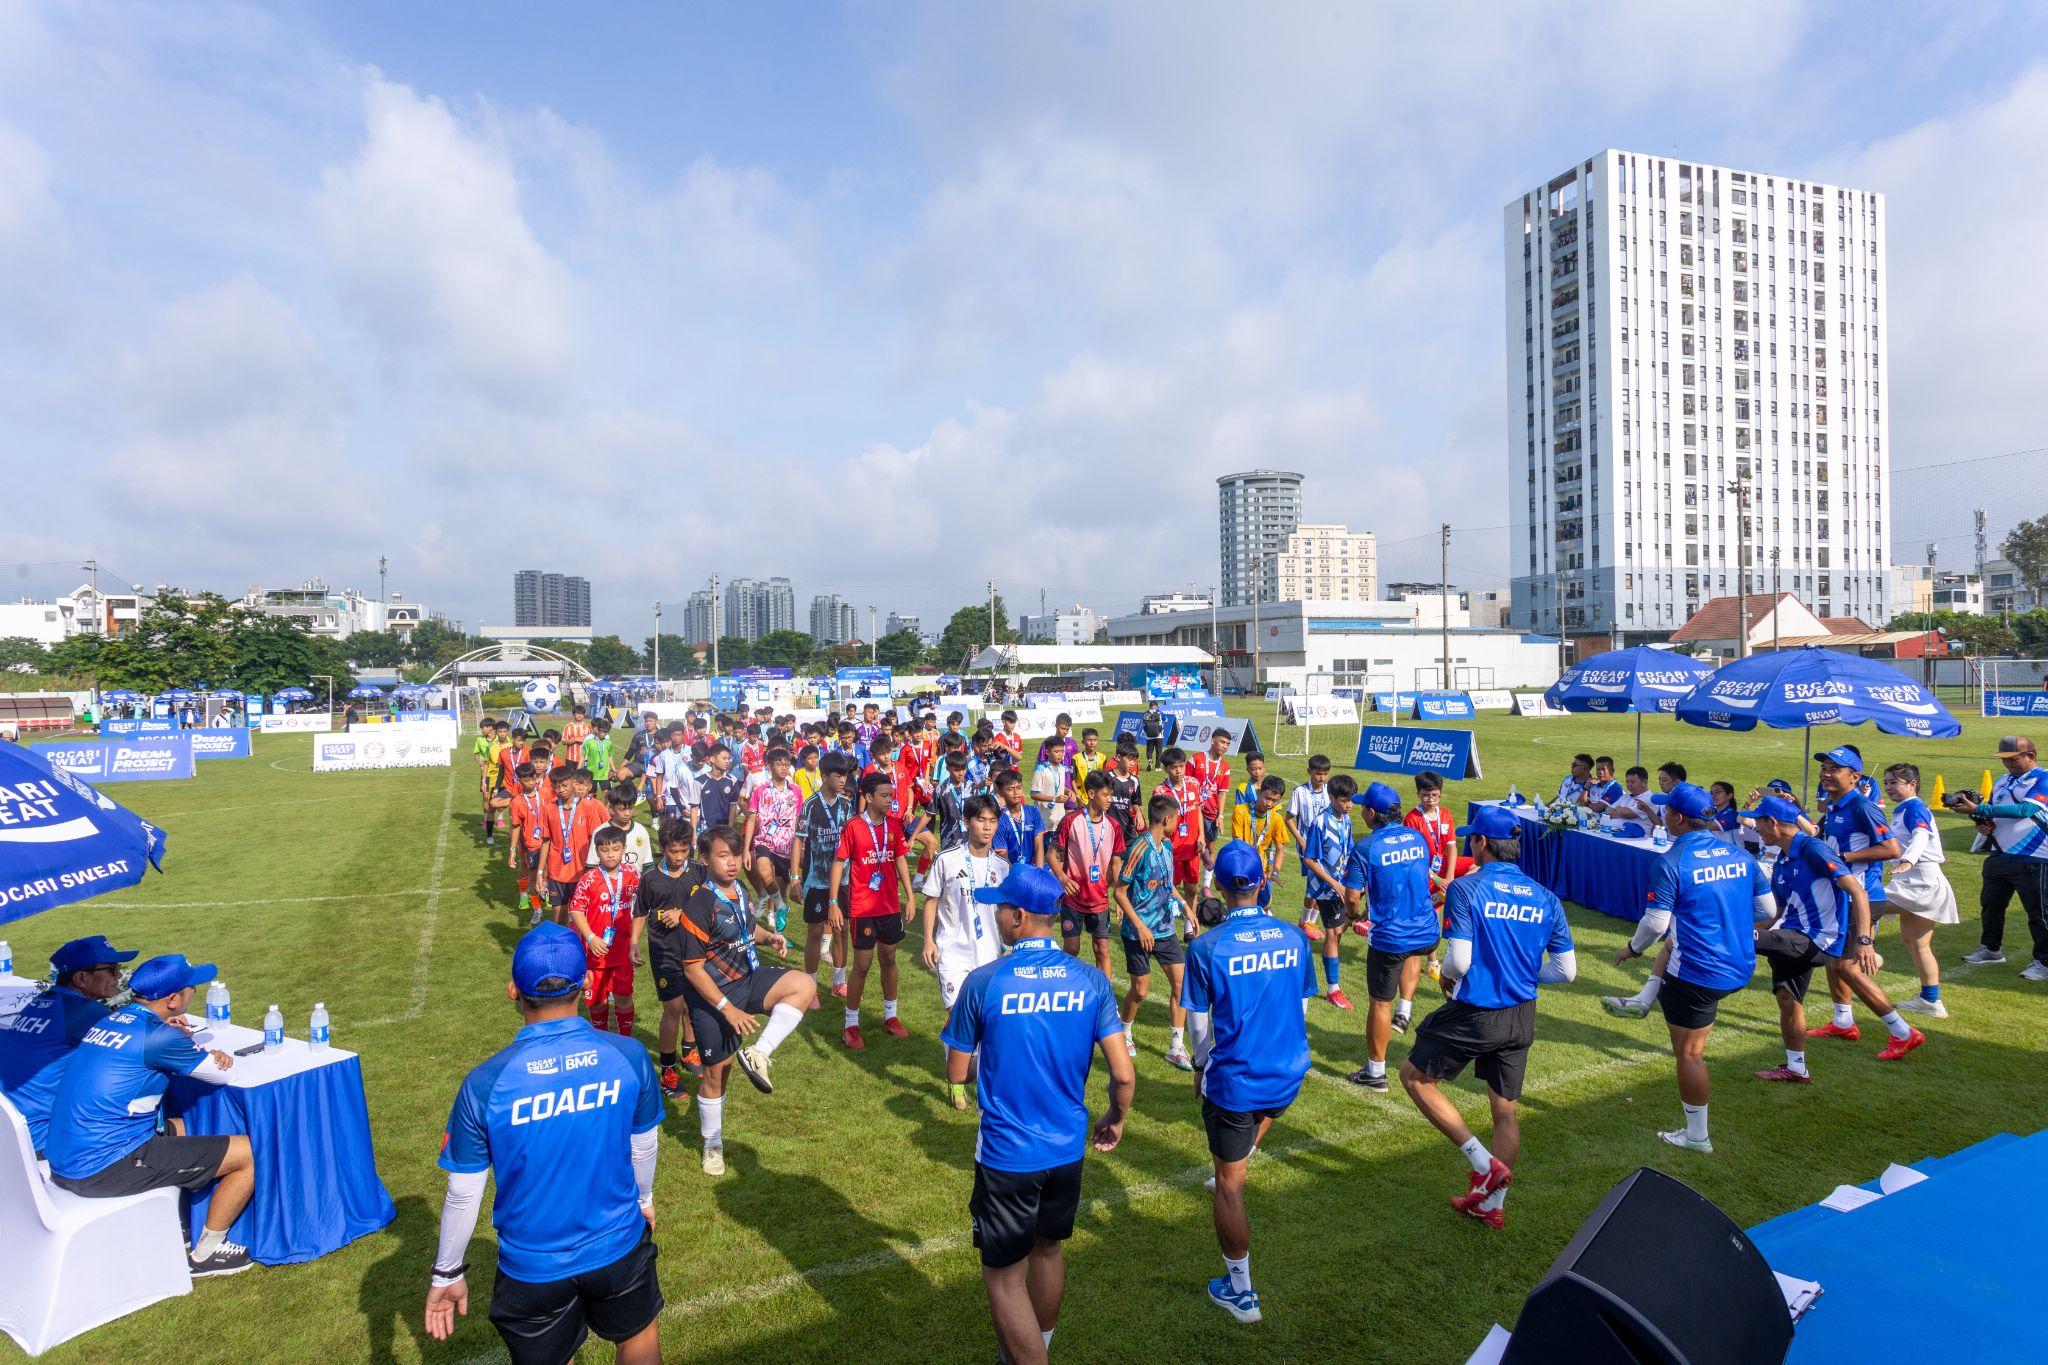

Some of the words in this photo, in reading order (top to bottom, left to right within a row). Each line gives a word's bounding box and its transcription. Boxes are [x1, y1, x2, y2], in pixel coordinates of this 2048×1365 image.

[1583, 670, 1630, 678] POCARI
[1636, 671, 1689, 679] POCARI
[1717, 680, 1771, 691] POCARI
[1784, 681, 1853, 692] POCARI
[1864, 685, 1920, 695] POCARI
[1711, 687, 1759, 697] SWEAT
[1785, 688, 1847, 698] SWEAT
[1870, 692, 1922, 702] SWEAT
[1805, 709, 1838, 718] POCARI
[191, 734, 233, 743] DREAM
[1370, 735, 1403, 745] POCARI
[1368, 743, 1399, 753] SWEAT
[1411, 737, 1453, 752] DREAM
[46, 749, 100, 760] POCARI
[115, 747, 172, 760] DREAM
[421, 746, 443, 754] BMG
[1408, 750, 1455, 768] PROJECT
[112, 757, 176, 773] PROJECT
[1381, 846, 1425, 867] COACH
[60, 860, 129, 888] SWEAT
[1692, 862, 1747, 885] COACH
[1513, 887, 1533, 896] BMG
[1484, 901, 1544, 924] COACH
[1261, 930, 1283, 941] BMG
[1229, 948, 1299, 976] COACH
[1042, 969, 1067, 979] BMG
[1001, 990, 1085, 1015] COACH
[114, 1014, 136, 1024] BMG
[526, 1058, 557, 1068] POCARI
[565, 1053, 598, 1071] BMG
[527, 1063, 555, 1072] SWEAT
[511, 1079, 621, 1126] COACH
